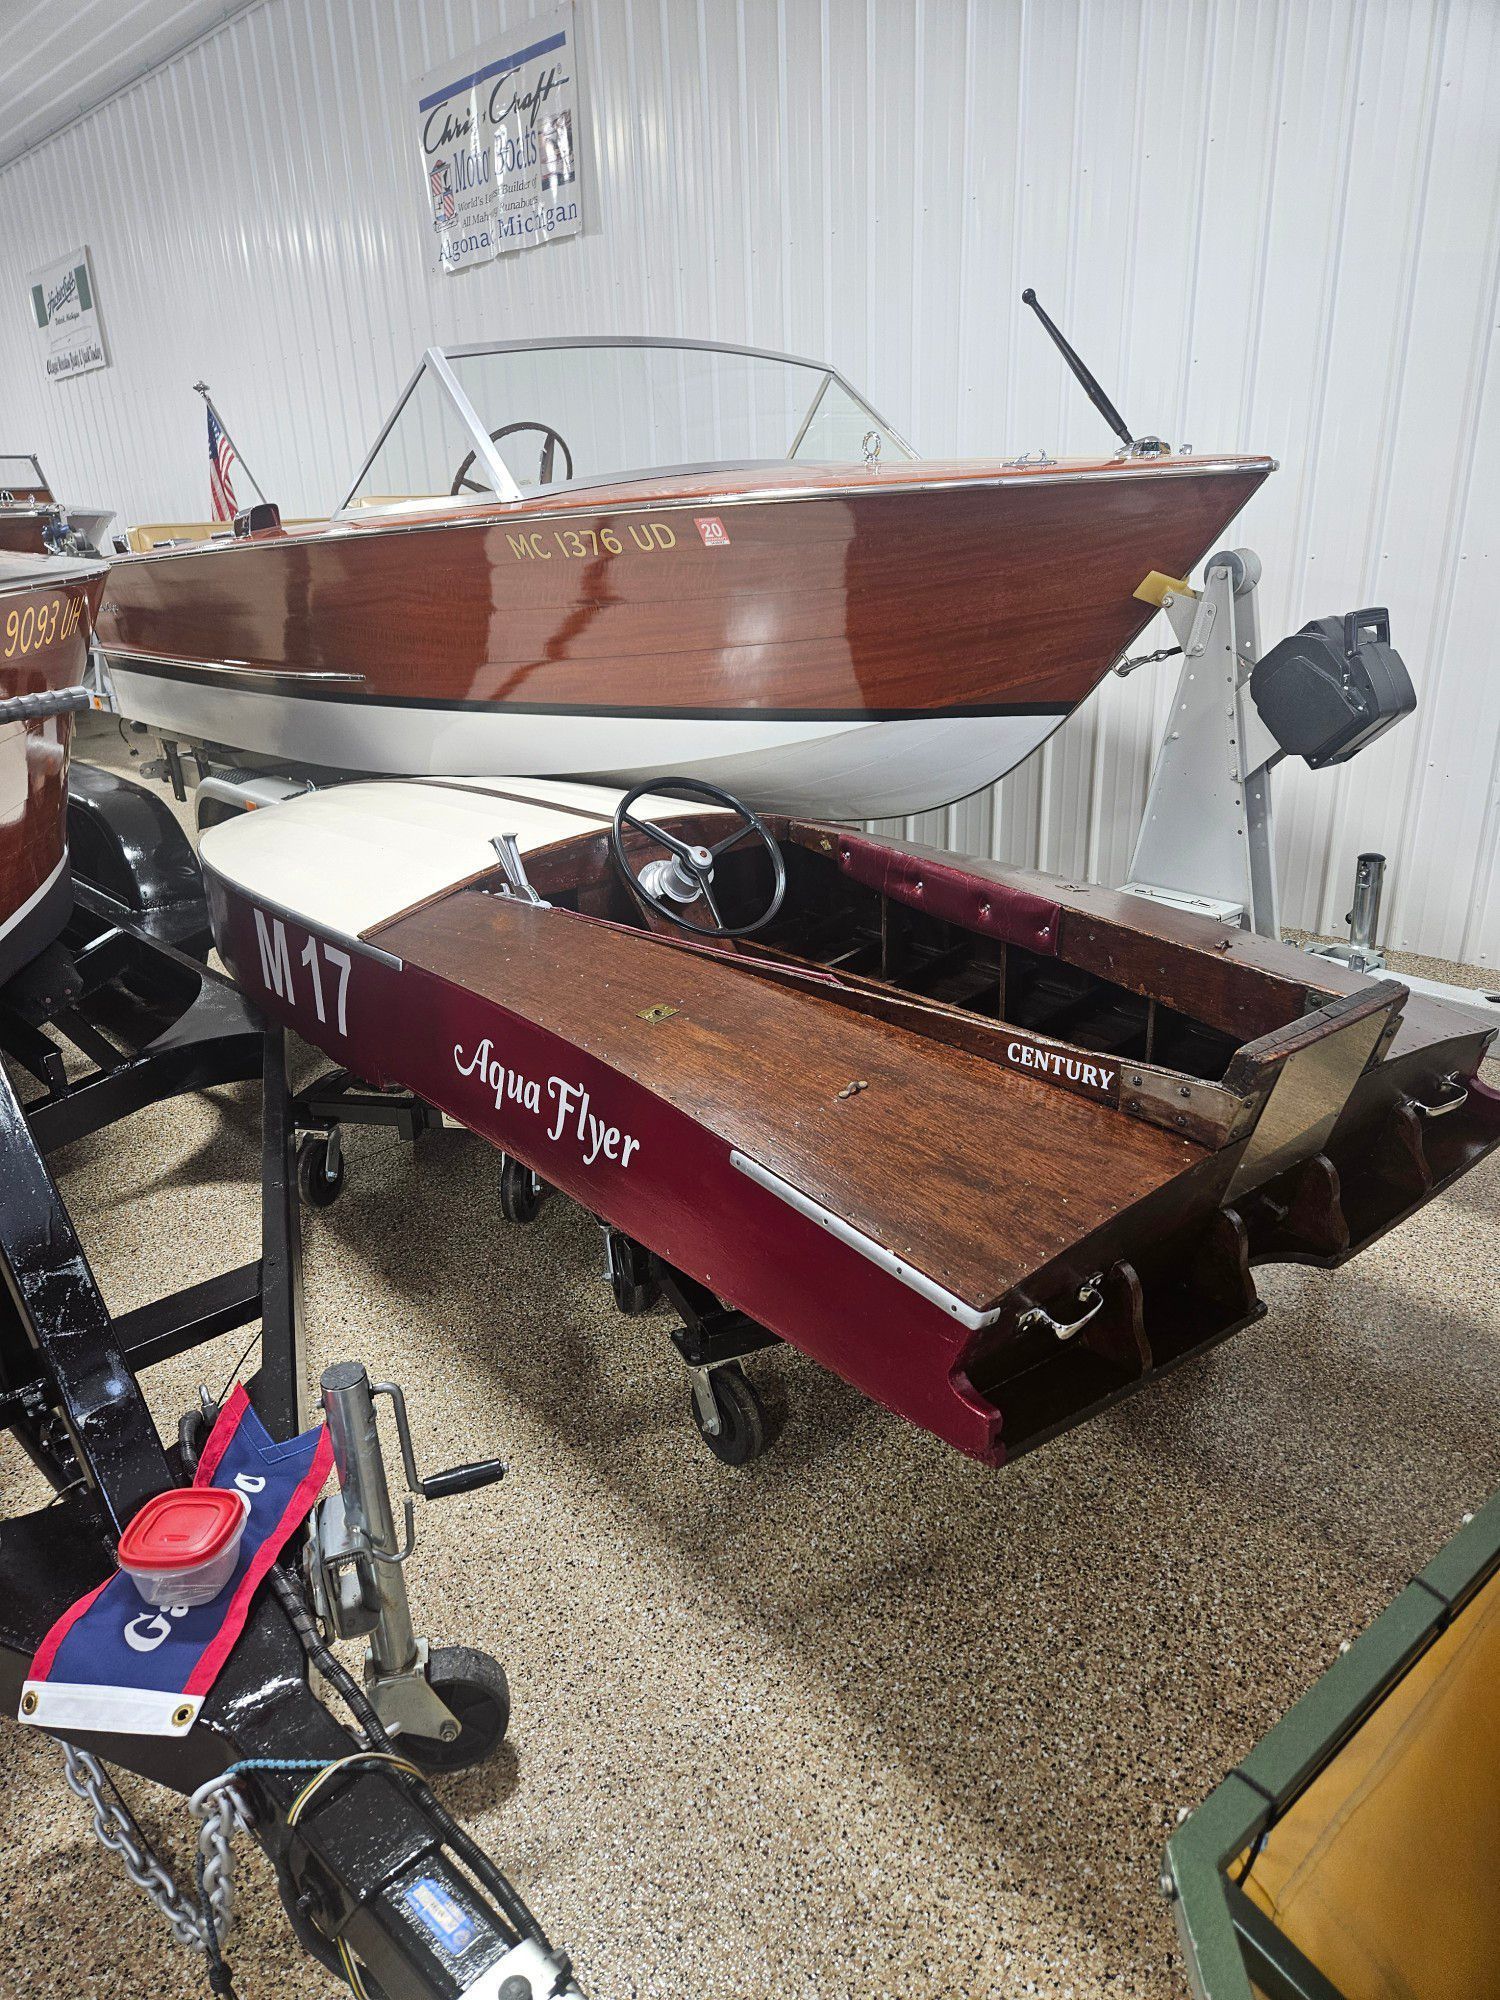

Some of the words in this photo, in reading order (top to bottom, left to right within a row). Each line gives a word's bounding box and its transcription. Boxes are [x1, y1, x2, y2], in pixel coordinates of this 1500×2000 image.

[423, 101, 479, 154] Chri
[458, 196, 484, 212] World's
[502, 180, 530, 194] Builder
[497, 202, 577, 238] Michigan
[505, 533, 552, 560] MC
[553, 528, 623, 558] 1376
[627, 523, 676, 551] UD
[701, 523, 722, 538] 20
[4, 600, 60, 657] 9093
[60, 595, 85, 640] UH
[1007, 1042, 1115, 1090] CENTURY
[453, 1038, 541, 1114] Aqua
[547, 1075, 640, 1168] Flyer
